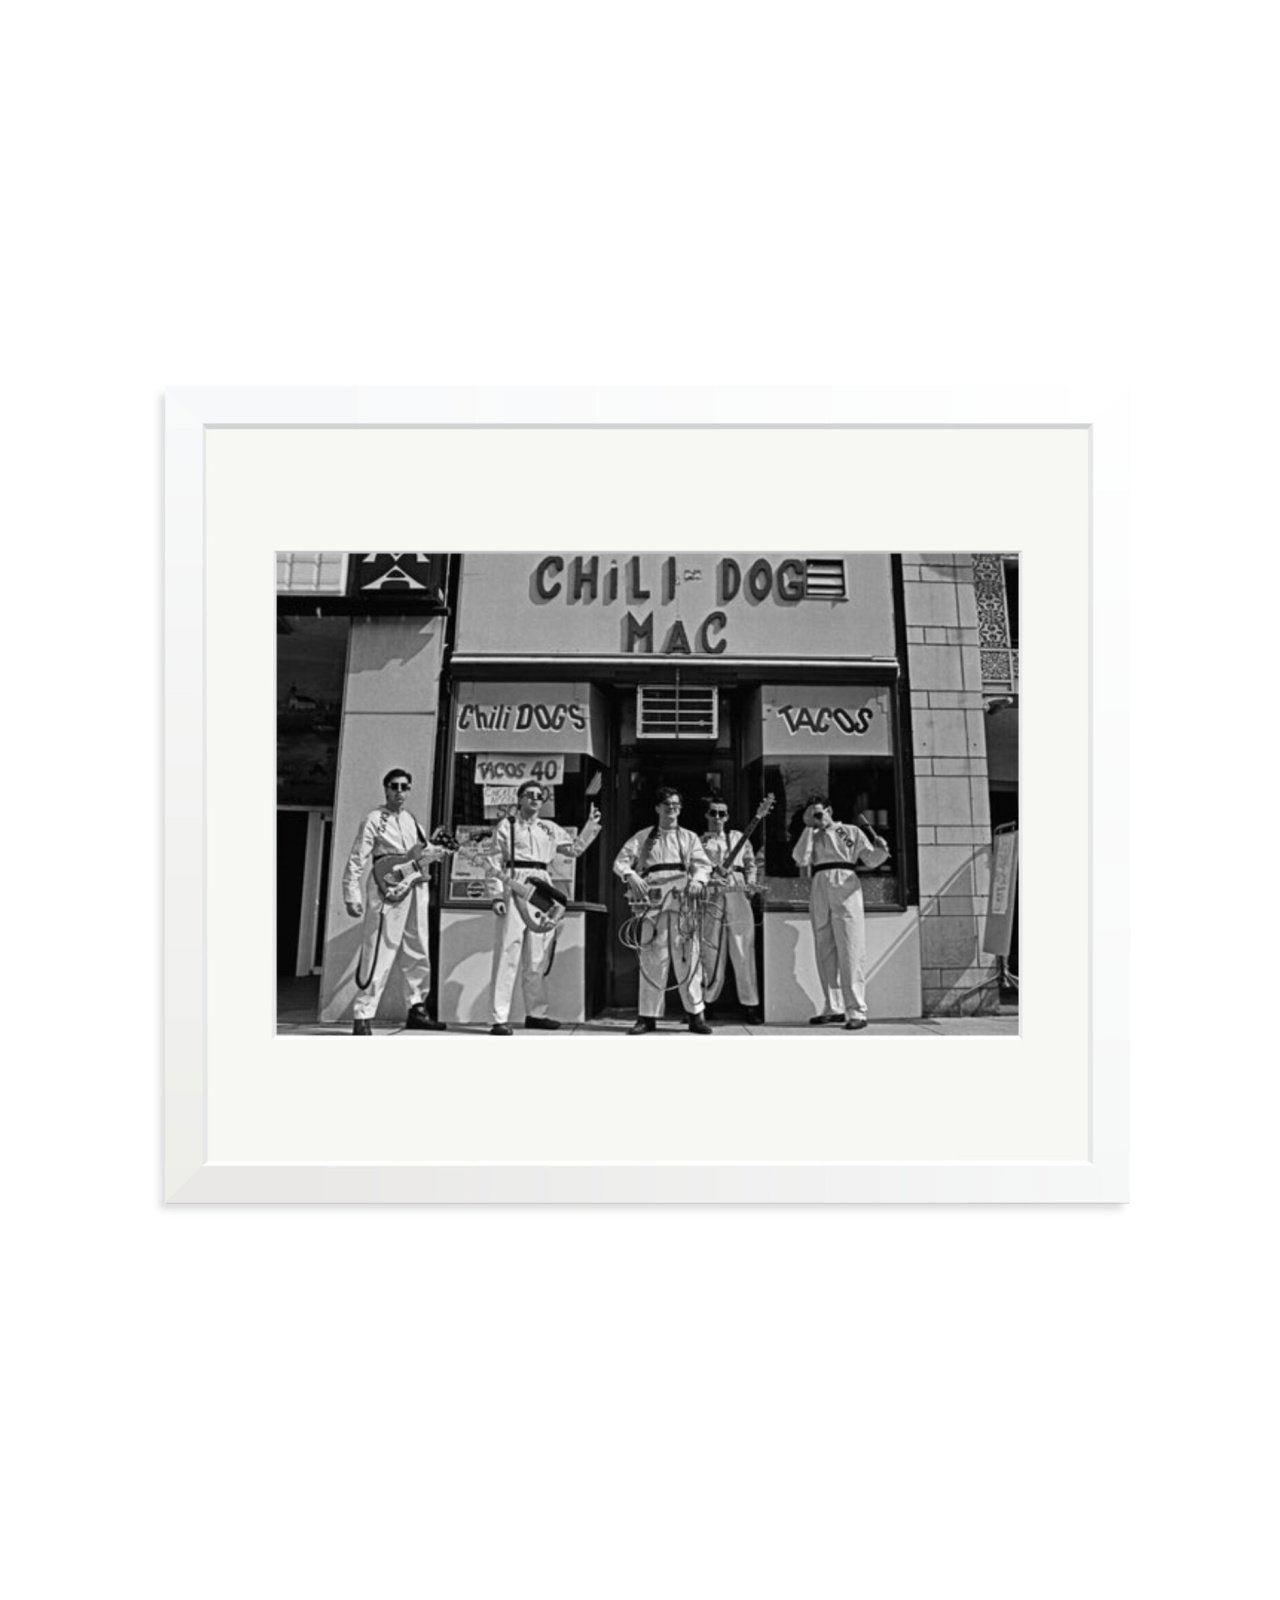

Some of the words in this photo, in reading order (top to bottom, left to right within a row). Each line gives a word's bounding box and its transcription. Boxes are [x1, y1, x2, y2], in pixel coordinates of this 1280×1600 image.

[717, 557, 806, 607] DOG
[620, 611, 727, 655] MAC
[515, 703, 586, 731] DOGS
[777, 705, 873, 735] TACOS
[478, 761, 526, 781] TACOS
[530, 759, 558, 781] 40
